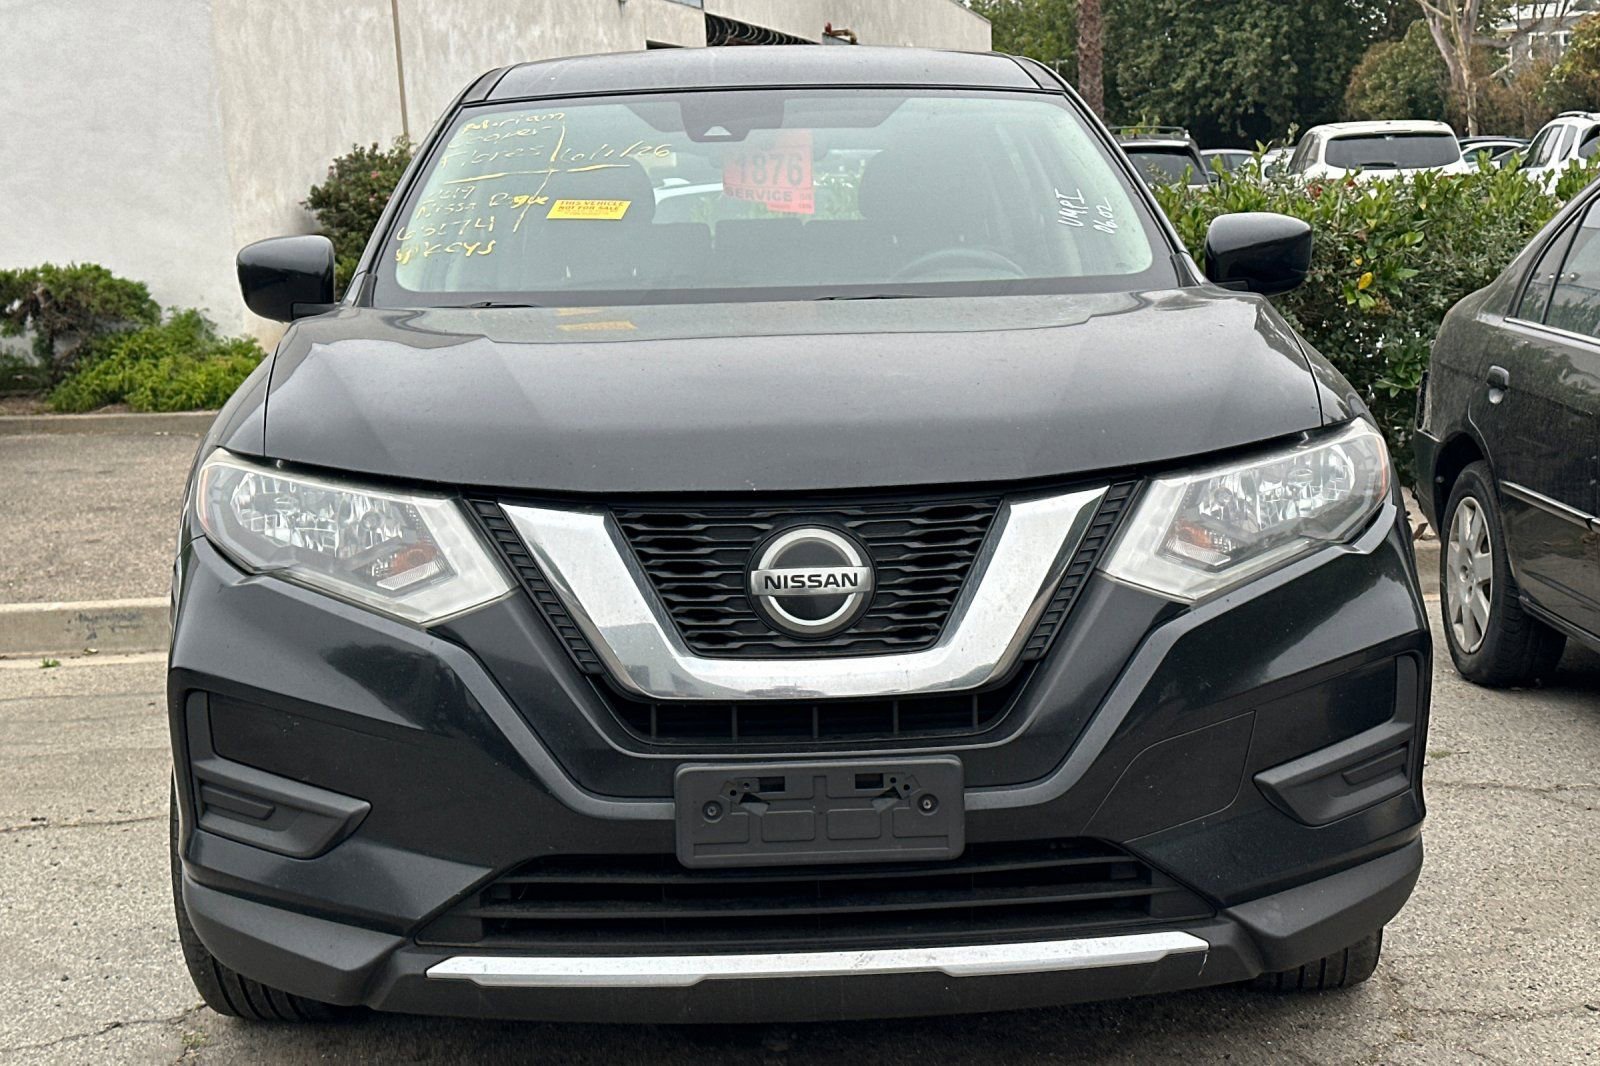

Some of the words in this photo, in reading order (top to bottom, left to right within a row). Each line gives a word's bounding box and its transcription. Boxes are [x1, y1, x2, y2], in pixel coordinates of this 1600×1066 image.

[736, 152, 804, 187] 1876
[724, 187, 793, 202] SERVICE
[764, 572, 858, 590] NISSAN
